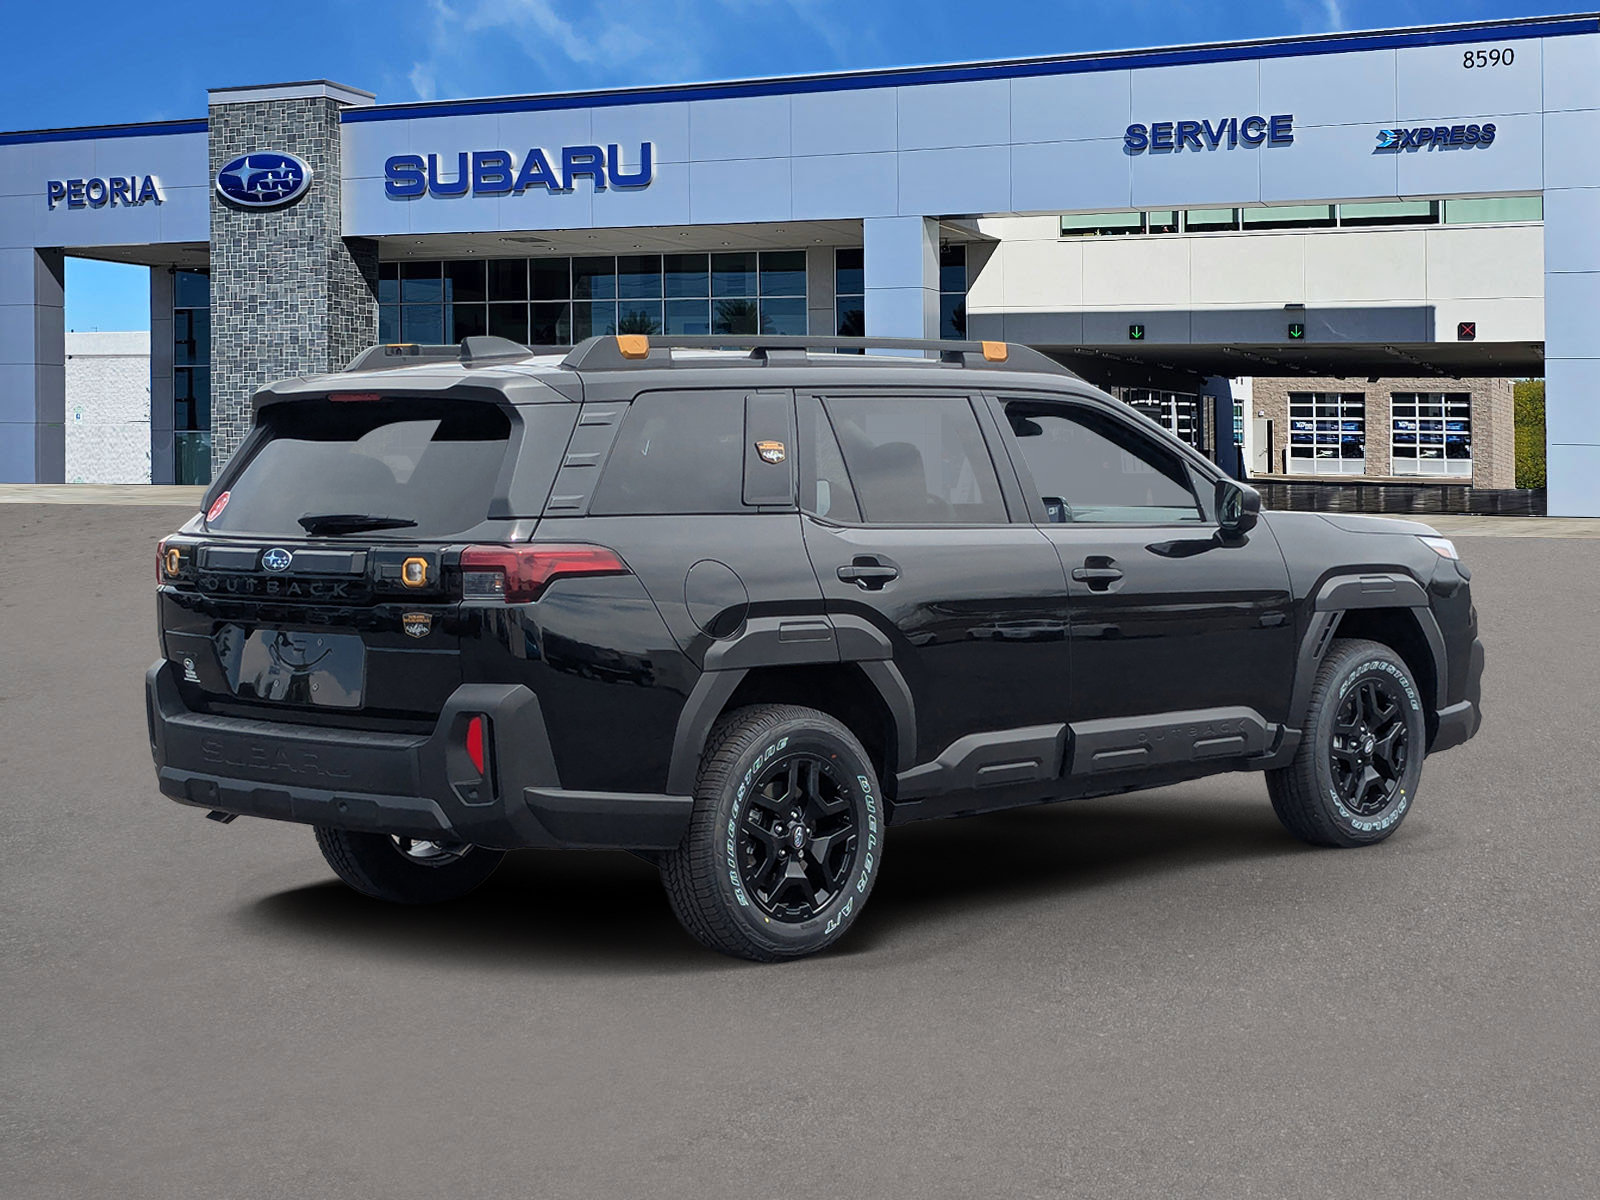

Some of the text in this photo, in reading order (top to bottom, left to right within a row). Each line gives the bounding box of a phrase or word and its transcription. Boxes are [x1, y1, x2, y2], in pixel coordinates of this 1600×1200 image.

[1463, 48, 1515, 69] 8590
[1125, 115, 1294, 152] SERVICE
[1375, 123, 1497, 151] EXPRESS
[384, 142, 653, 199] SUBARU
[48, 175, 162, 208] PEORIA
[205, 577, 349, 598] OUTBACK
